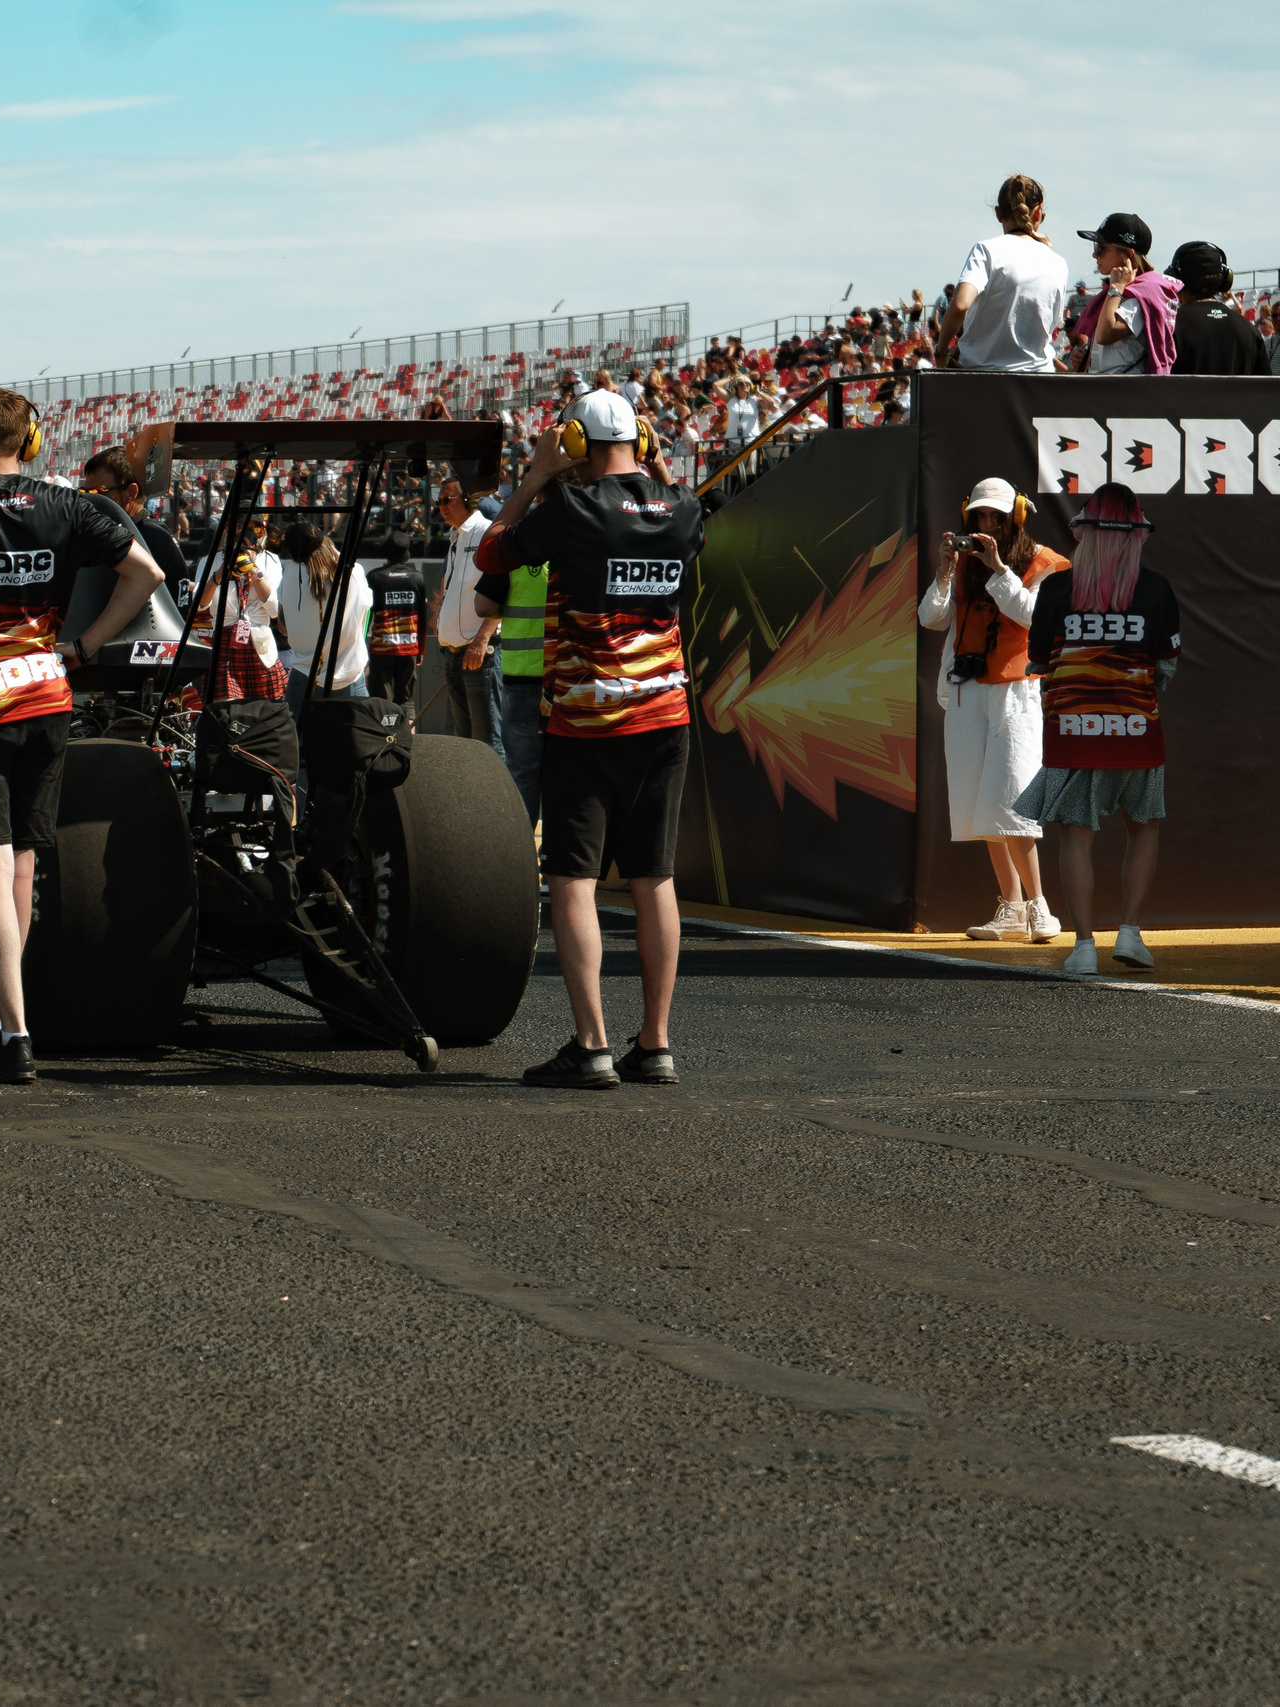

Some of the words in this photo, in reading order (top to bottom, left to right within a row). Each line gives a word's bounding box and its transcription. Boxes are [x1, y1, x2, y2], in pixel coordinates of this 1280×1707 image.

[610, 560, 681, 583] RDRC
[386, 592, 414, 600] RDRC
[609, 584, 677, 593] TECHNOLOGY
[1064, 614, 1145, 642] 8333
[1058, 714, 1147, 736] RDRC
